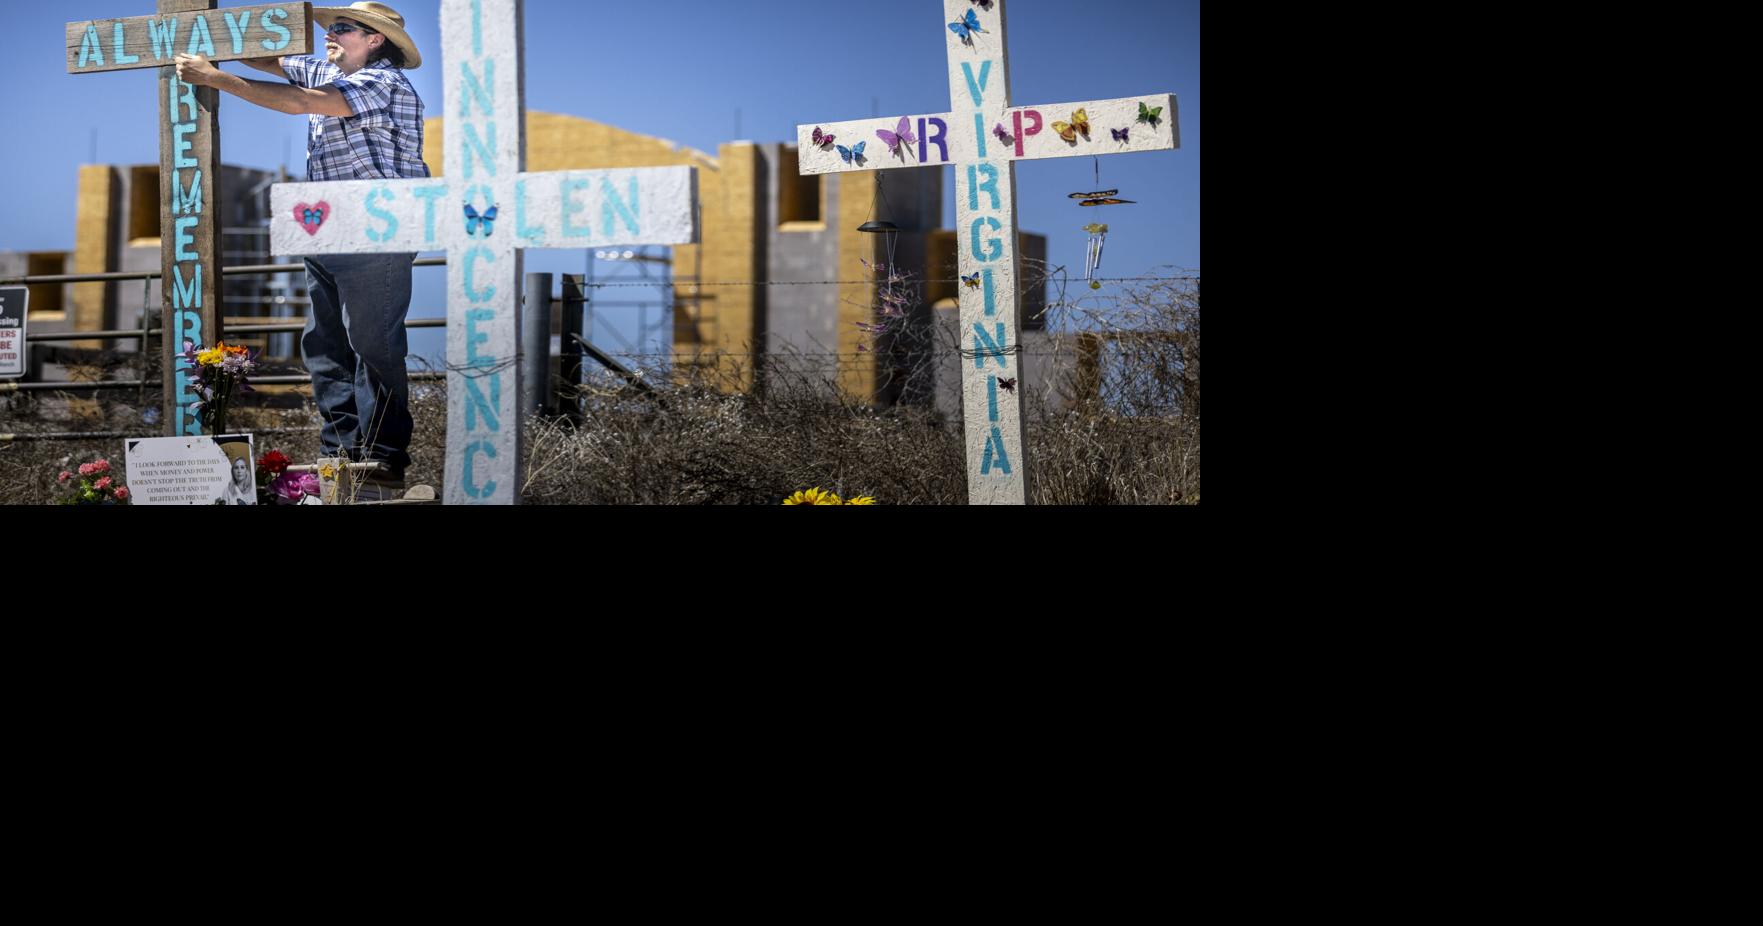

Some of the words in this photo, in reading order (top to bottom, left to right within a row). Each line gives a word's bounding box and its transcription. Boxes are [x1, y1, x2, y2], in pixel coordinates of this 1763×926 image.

[77, 8, 292, 68] ALWAYS
[364, 175, 640, 244] STOLEN
[169, 73, 203, 437] REMEMBER
[960, 60, 1012, 476] VIRGINIA
[156, 460, 186, 468] FORWARD
